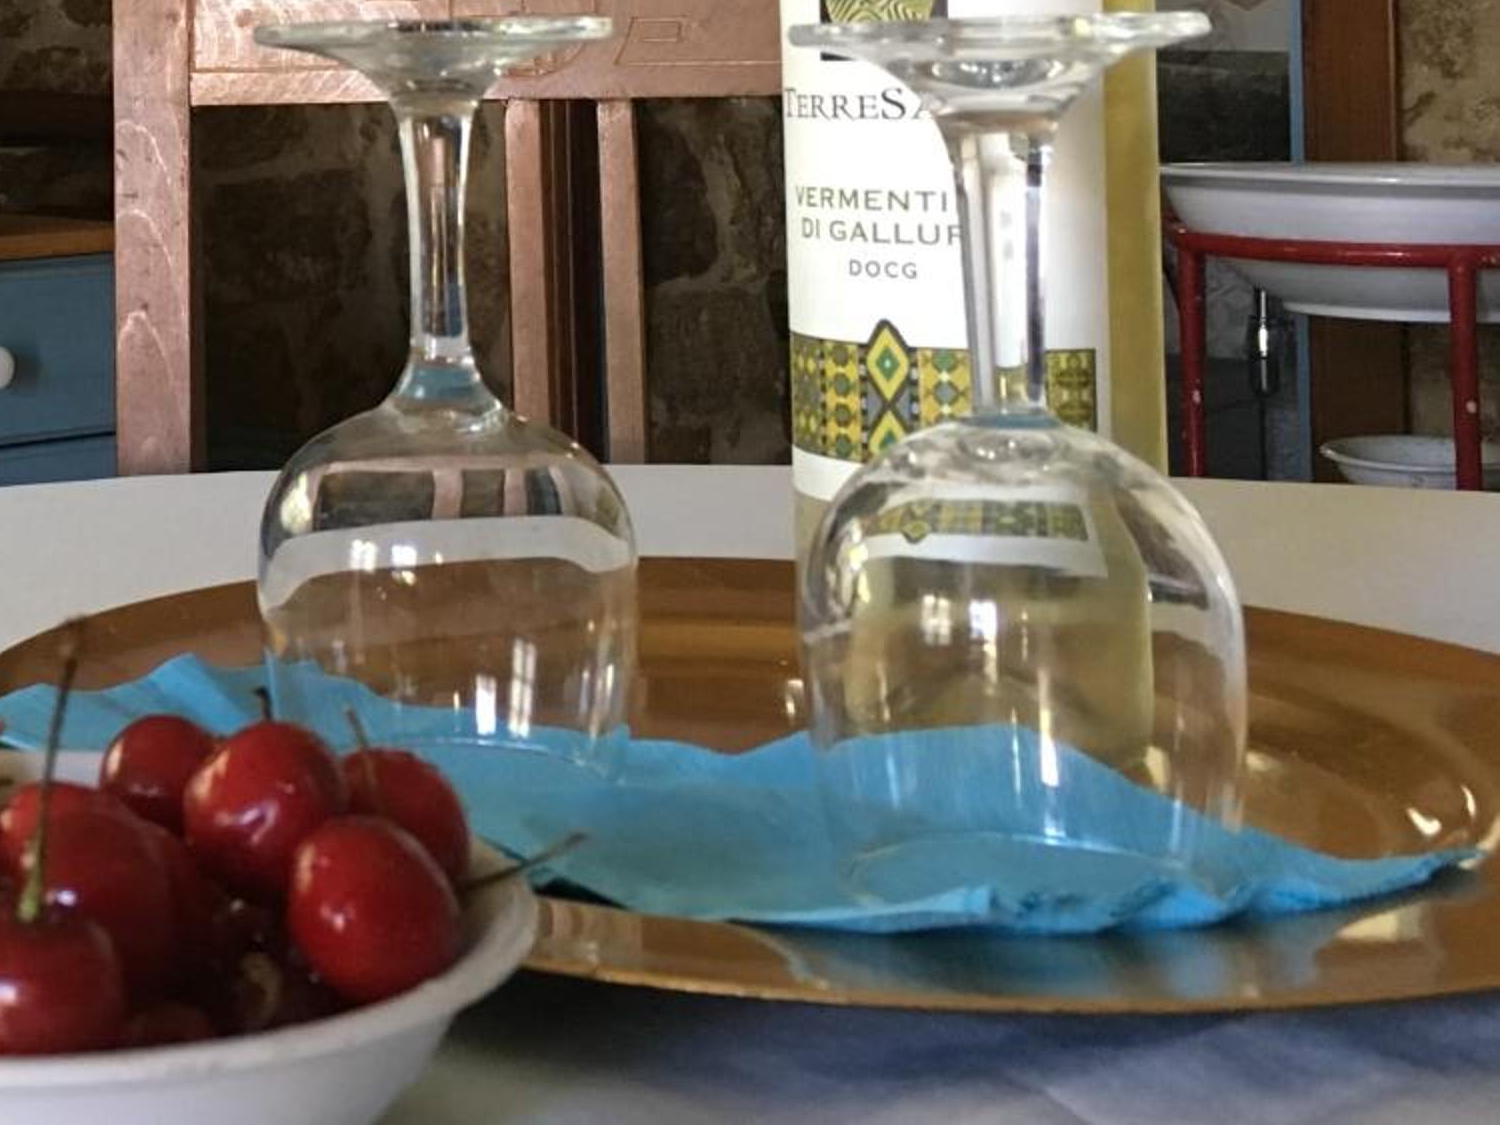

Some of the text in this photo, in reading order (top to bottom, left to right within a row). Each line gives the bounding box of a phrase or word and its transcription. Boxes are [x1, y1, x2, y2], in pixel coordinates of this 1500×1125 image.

[795, 185, 949, 213] VERMENTI
[801, 216, 821, 240] DI
[848, 258, 918, 280] DOCG
